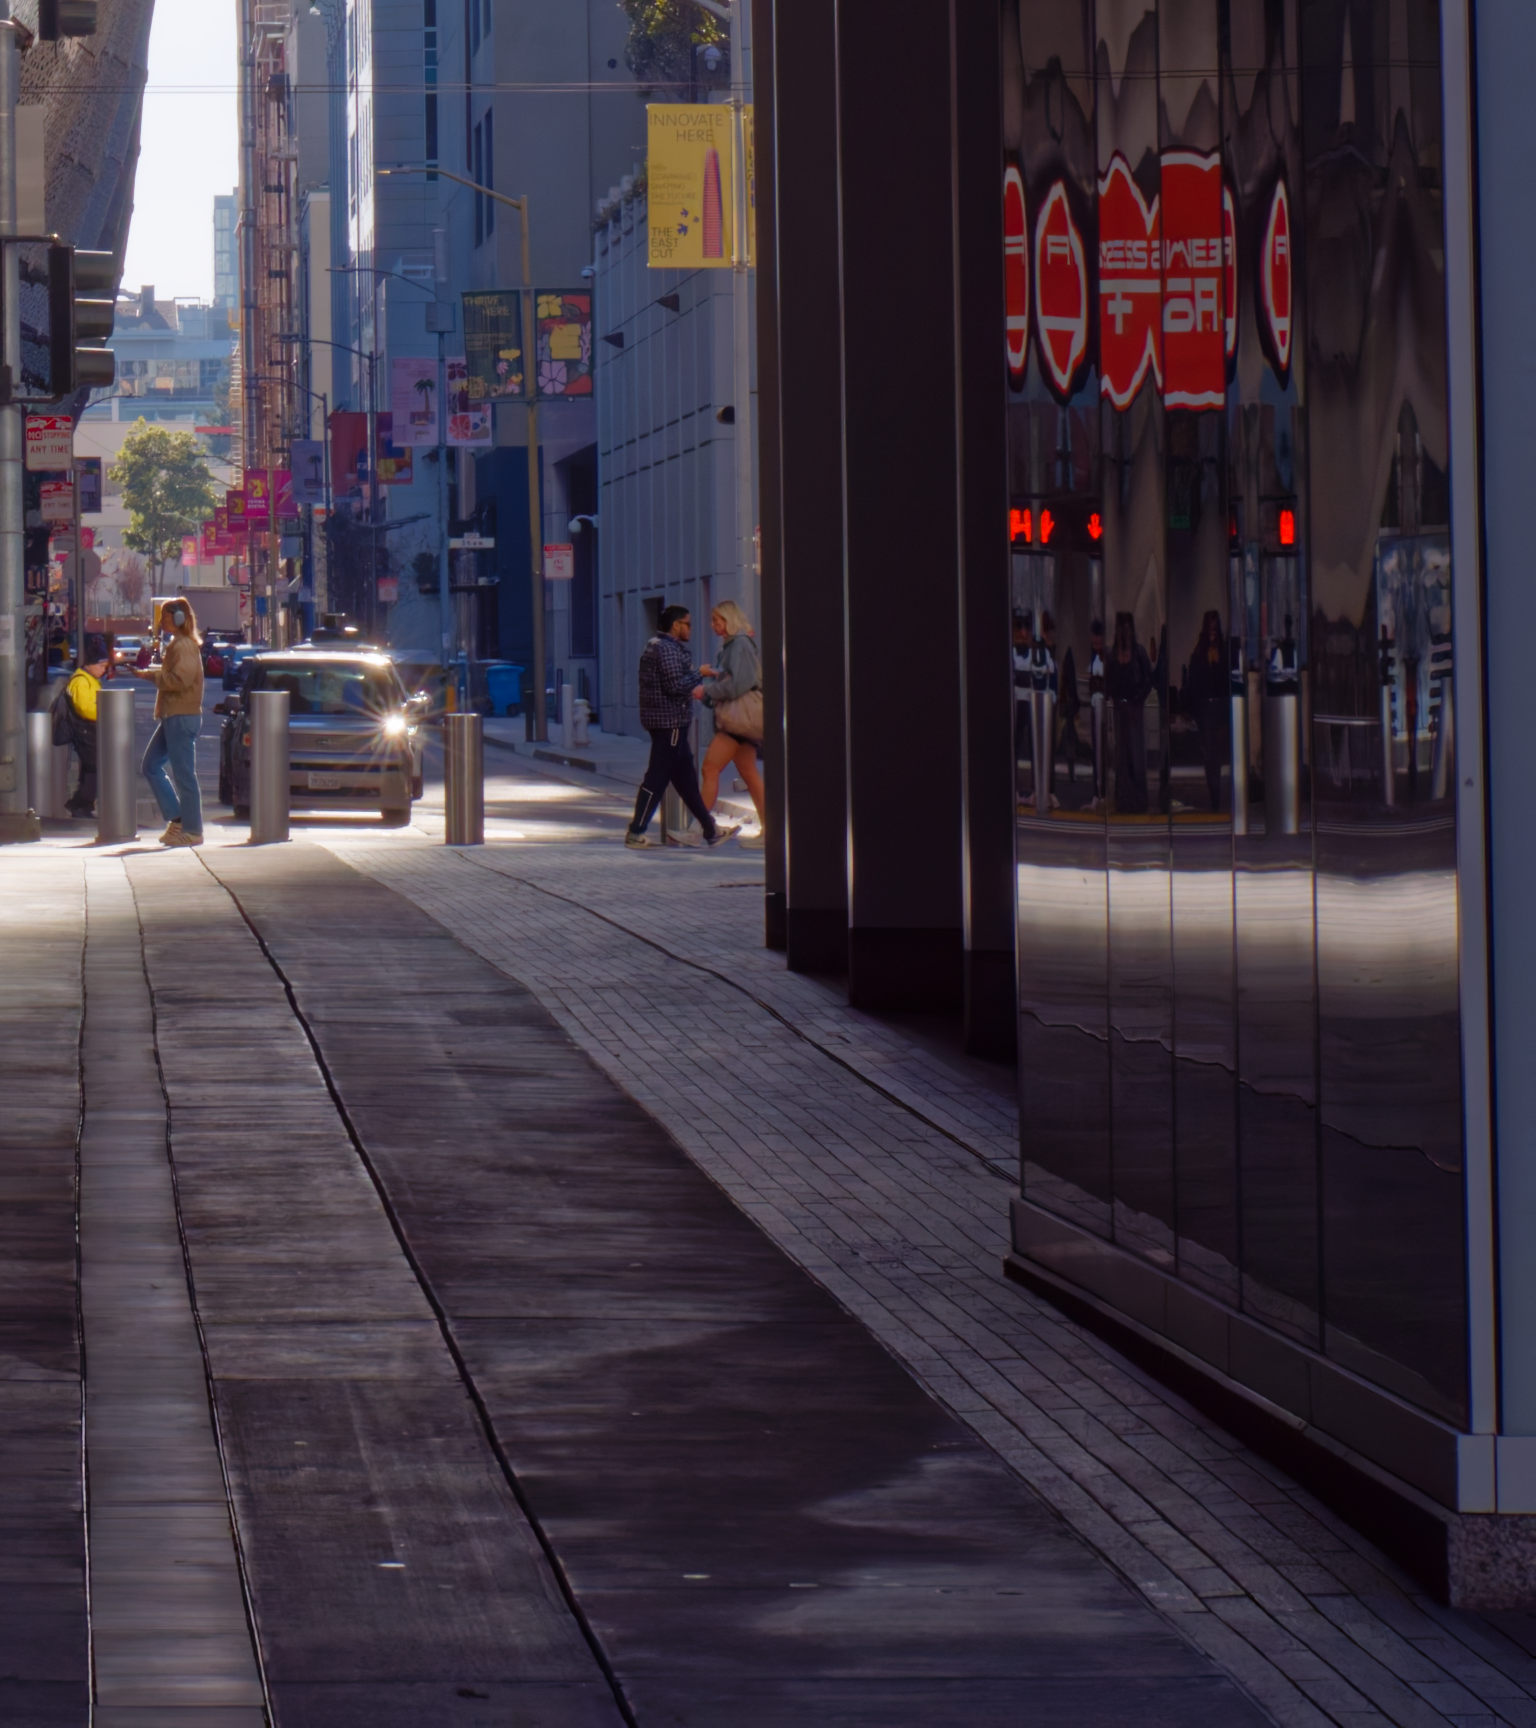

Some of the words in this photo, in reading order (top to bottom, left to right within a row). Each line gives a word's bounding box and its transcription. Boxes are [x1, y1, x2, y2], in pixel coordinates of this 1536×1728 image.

[649, 113, 724, 126] INNOVATE
[676, 129, 715, 142] HERE
[651, 227, 672, 237] THE
[651, 238, 678, 248] EAST
[651, 249, 673, 258] CUT
[30, 445, 46, 453] ANY
[50, 445, 68, 453] TIME
